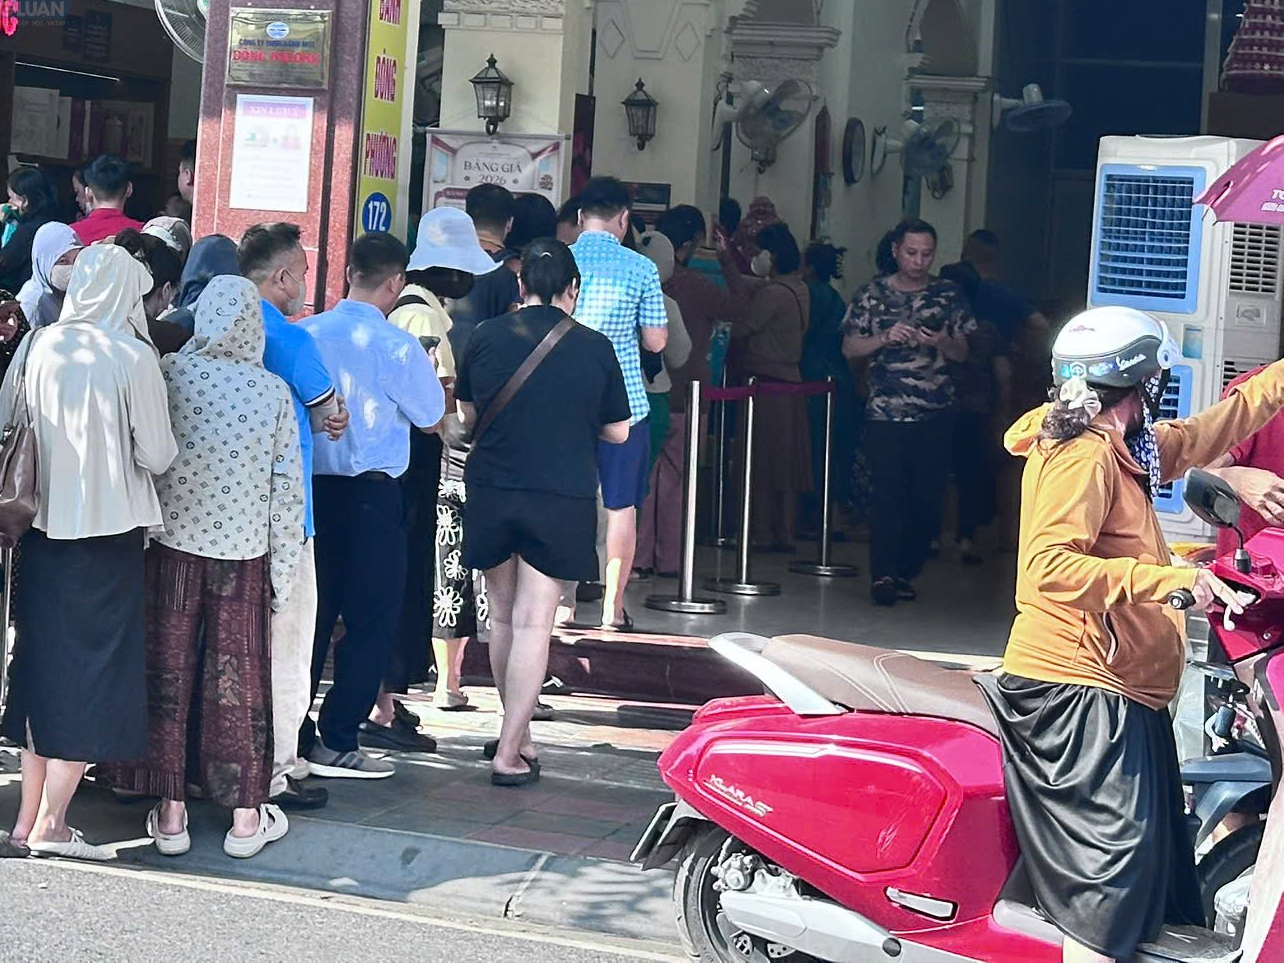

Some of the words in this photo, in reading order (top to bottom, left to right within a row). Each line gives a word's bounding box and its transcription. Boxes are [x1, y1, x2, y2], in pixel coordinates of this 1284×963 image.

[363, 130, 397, 180] PHƯƠNG
[463, 158, 499, 173] BẢNG
[367, 200, 386, 232] 172
